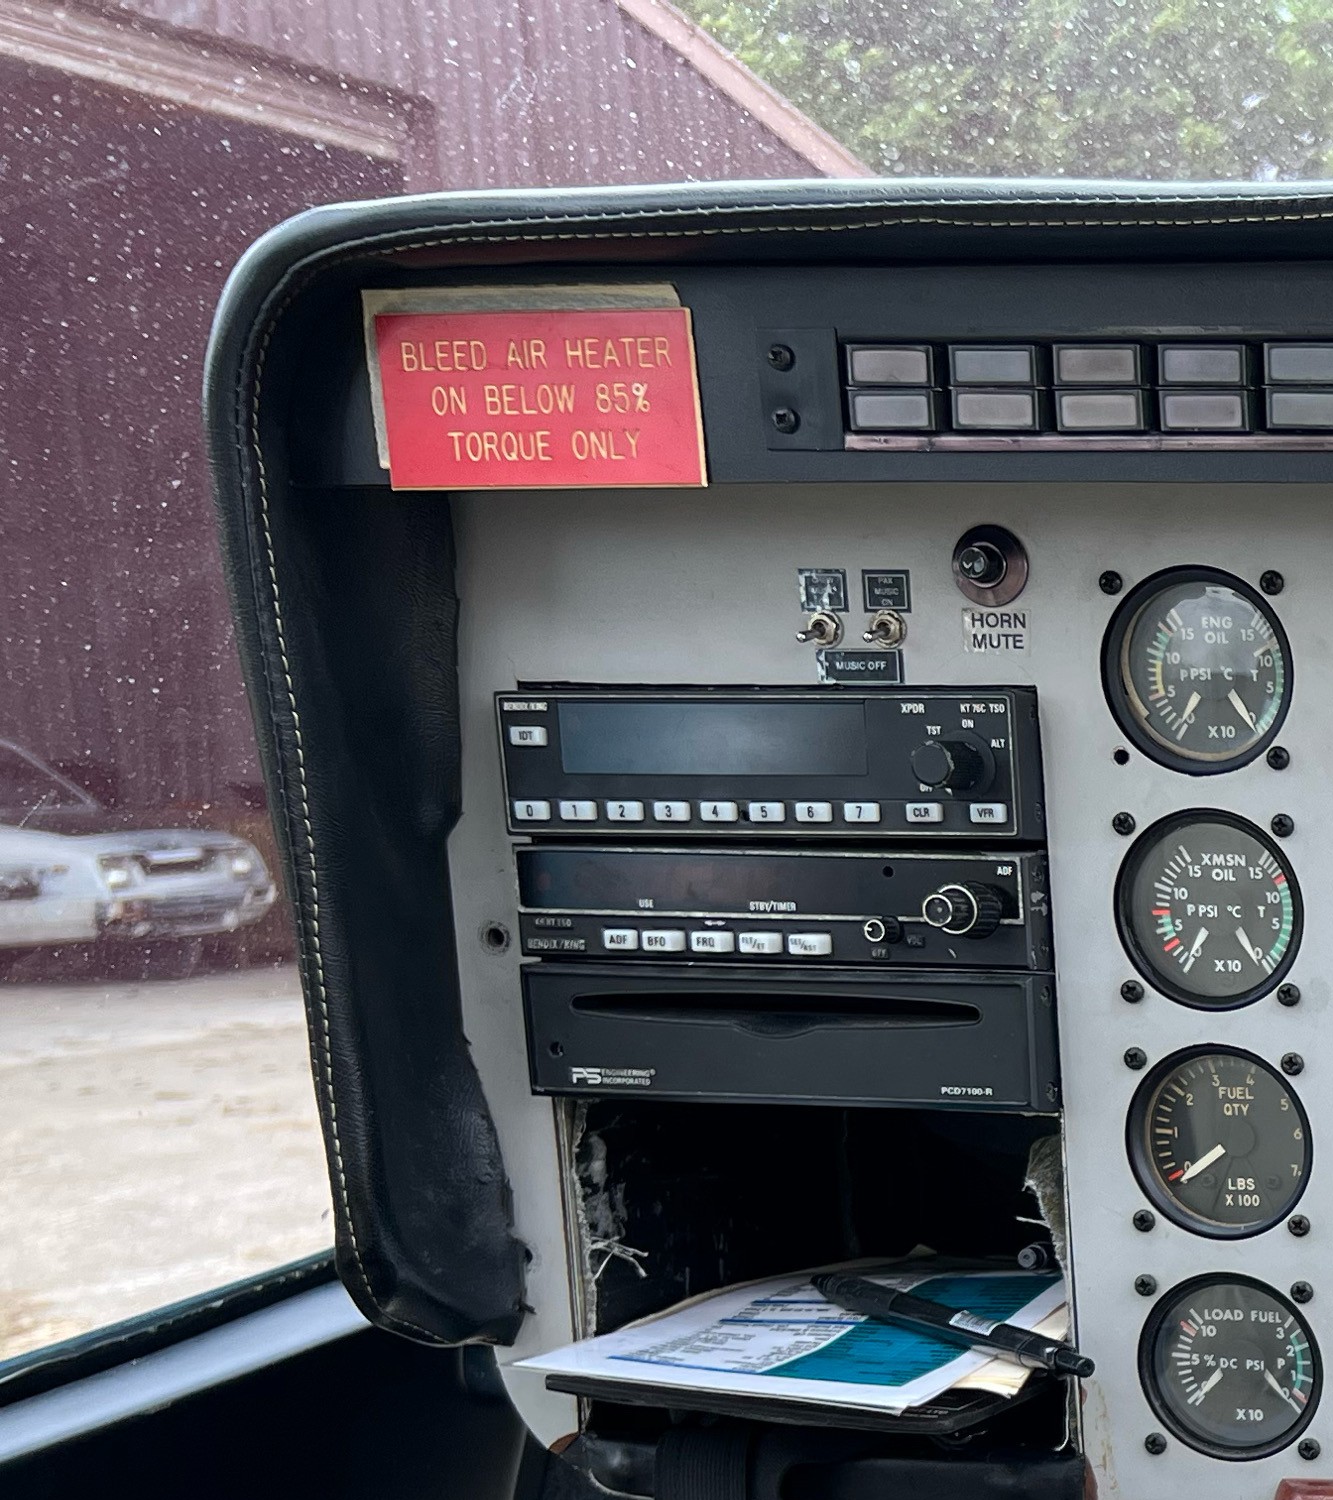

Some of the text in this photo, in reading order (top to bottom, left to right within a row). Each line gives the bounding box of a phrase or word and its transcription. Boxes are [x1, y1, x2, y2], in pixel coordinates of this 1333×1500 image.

[401, 337, 672, 372] BLEED AIR HEATER
[432, 382, 650, 416] ON BELOW 85%
[448, 428, 640, 462] TORQUE ONLY
[972, 612, 1026, 629] HORN
[1201, 616, 1233, 630] ENG
[972, 634, 1024, 649] MUTE
[1205, 630, 1229, 644] OIL
[1201, 853, 1246, 866] XMSN
[1212, 868, 1236, 882] OIL
[1218, 1086, 1255, 1100] FUEL
[1223, 1103, 1250, 1117] QTY
[1228, 1177, 1256, 1191] LBS
[1204, 1308, 1280, 1324] LOAD FUEL
